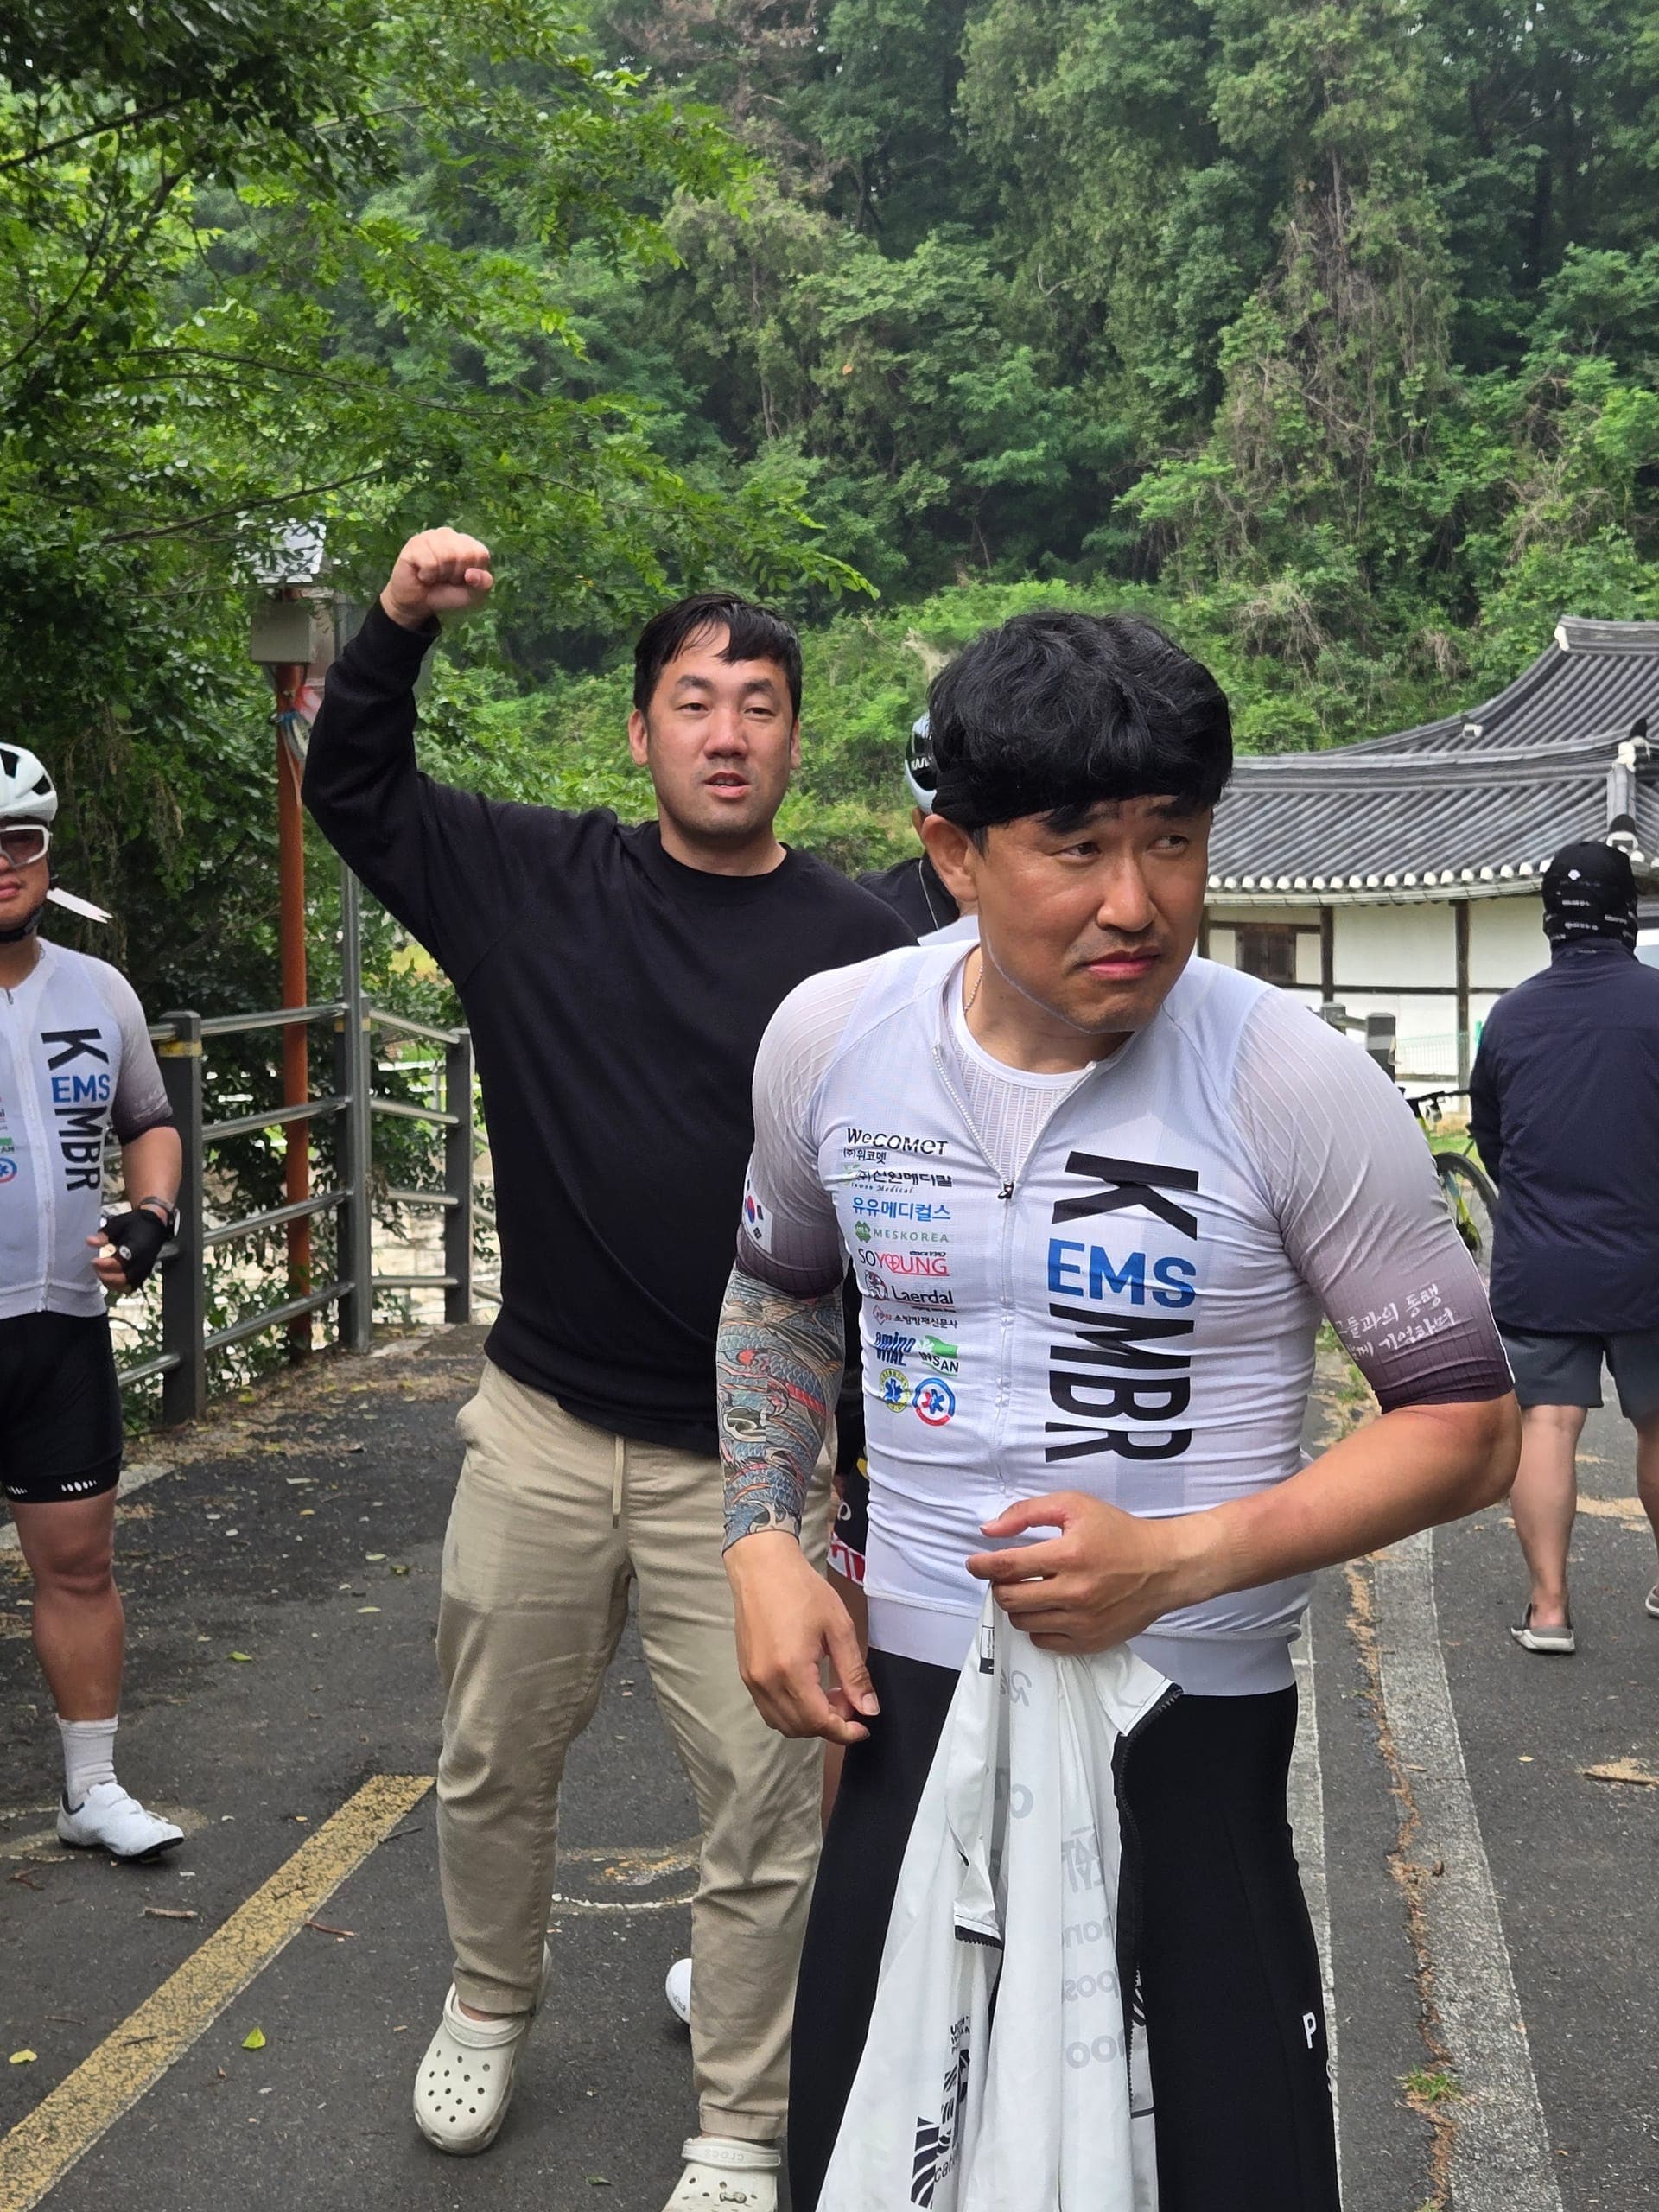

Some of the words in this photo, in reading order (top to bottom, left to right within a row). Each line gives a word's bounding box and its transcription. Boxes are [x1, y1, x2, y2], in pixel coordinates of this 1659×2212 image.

[41, 1028, 109, 1071] K
[51, 1074, 111, 1103] EMS
[54, 1105, 107, 1191] MBR
[852, 1197, 951, 1222] 유유메디컬스
[1052, 1150, 1199, 1241] K
[874, 1228, 949, 1243] MESKOREA
[1048, 1238, 1197, 1308] EMS
[891, 1285, 954, 1305] Laerdal
[918, 1351, 959, 1373] INSAN
[1045, 1302, 1195, 1463] MBR
